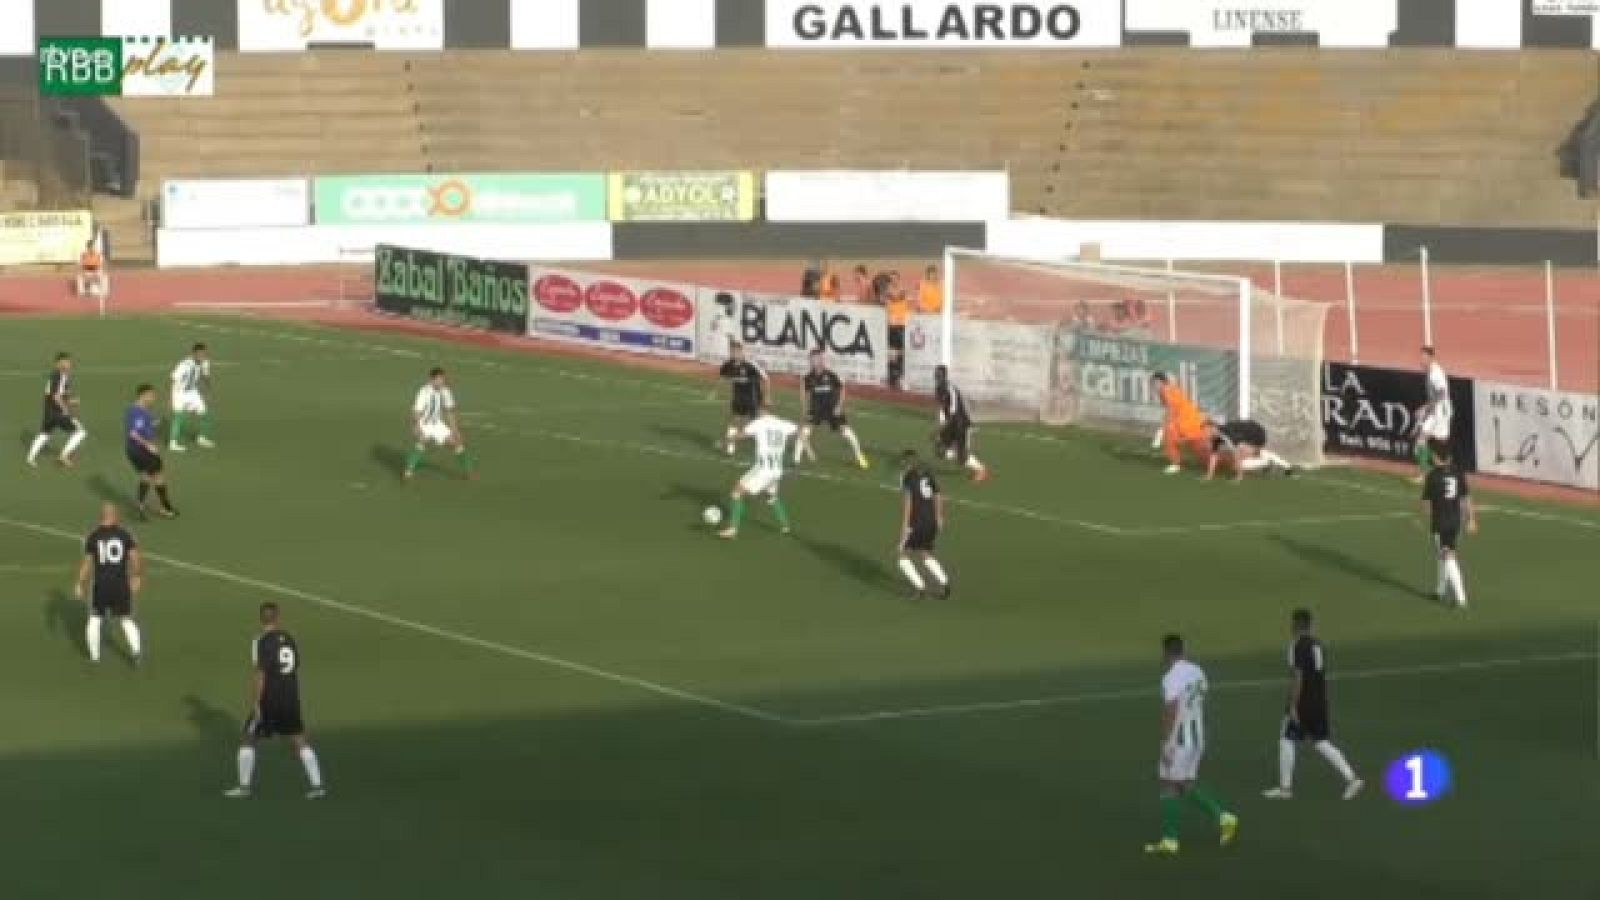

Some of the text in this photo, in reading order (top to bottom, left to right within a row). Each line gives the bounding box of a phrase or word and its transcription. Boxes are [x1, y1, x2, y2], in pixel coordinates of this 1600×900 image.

[792, 4, 1081, 41] GALLARDO
[1212, 8, 1303, 31] LINENSE
[740, 302, 874, 358] BLANCA
[1324, 362, 1366, 396] LA
[919, 476, 933, 499] 6
[1444, 476, 1458, 499] 3
[97, 538, 123, 565] 10
[279, 646, 295, 674] 9
